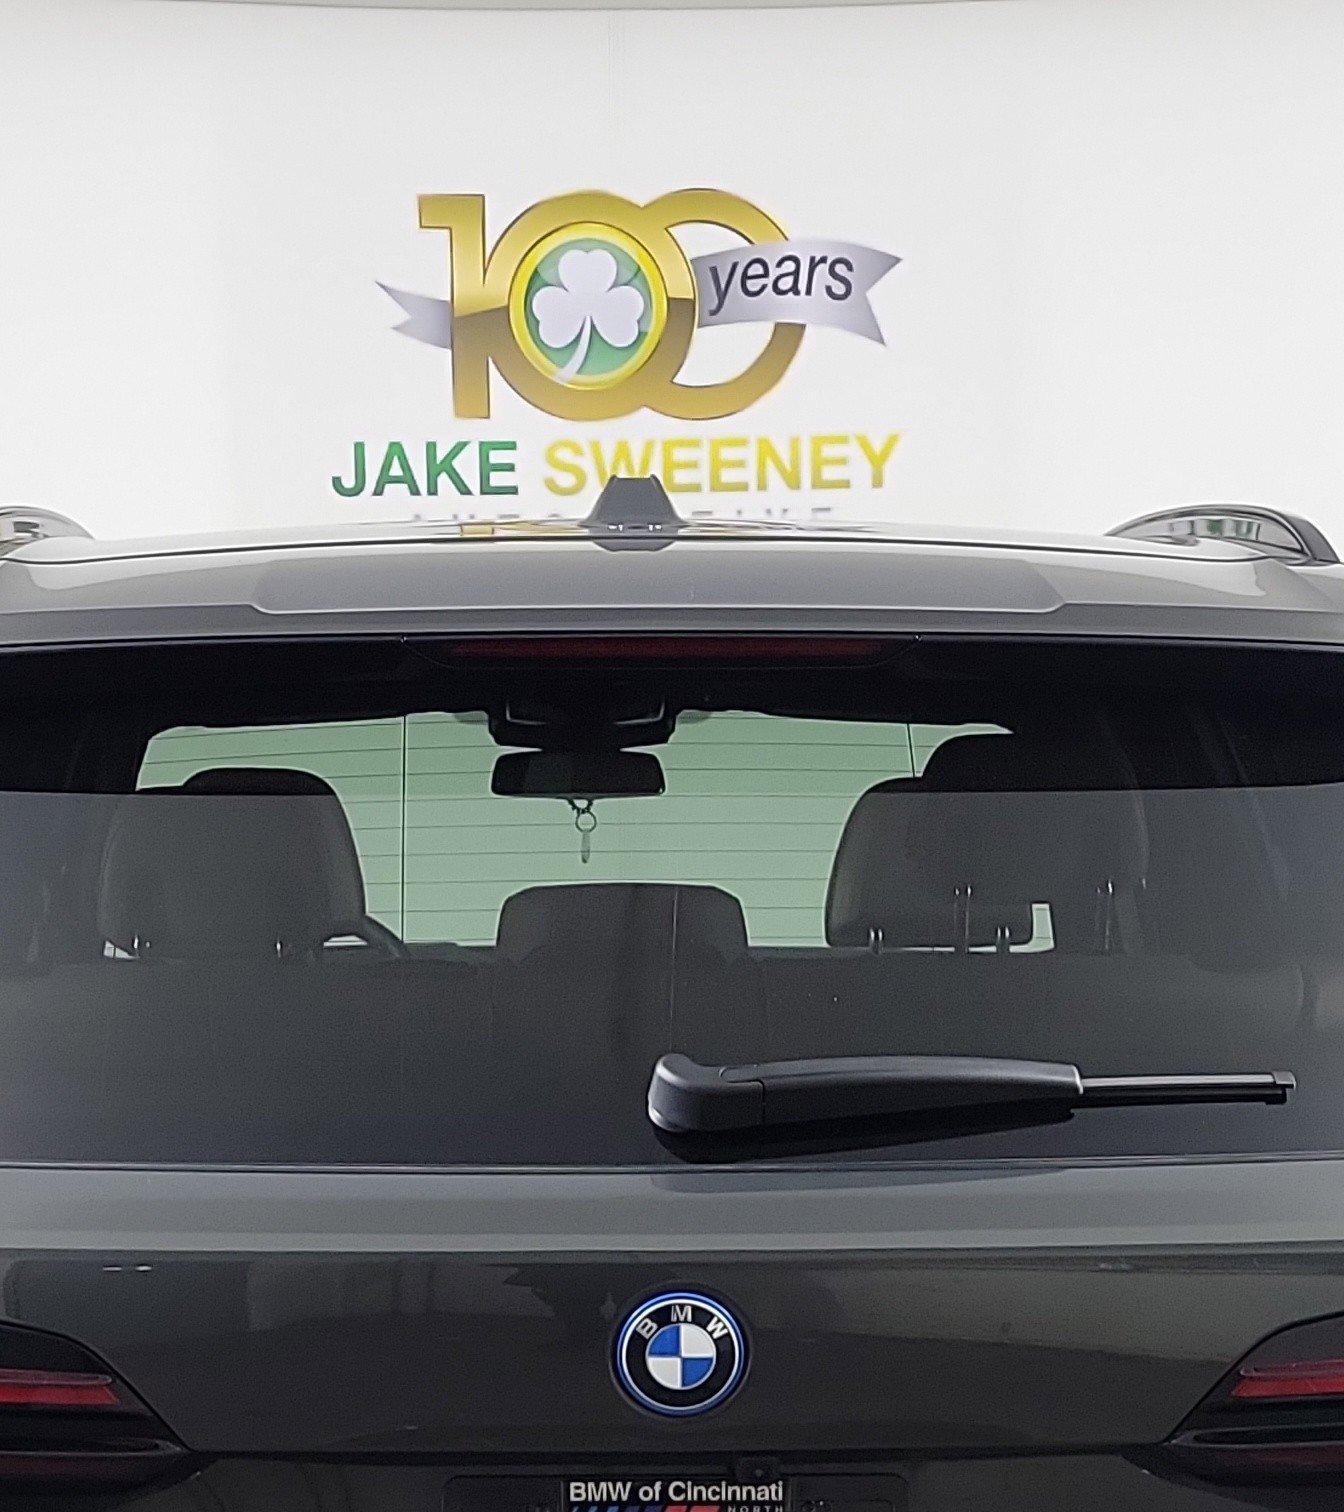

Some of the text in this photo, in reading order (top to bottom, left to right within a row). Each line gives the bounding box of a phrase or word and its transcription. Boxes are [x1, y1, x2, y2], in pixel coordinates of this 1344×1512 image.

[417, 188, 855, 421] 100 years
[332, 434, 902, 497] JAKE SWEENEY
[636, 1305, 729, 1340] BMW
[569, 1481, 784, 1502] BMW of Cincinnati
